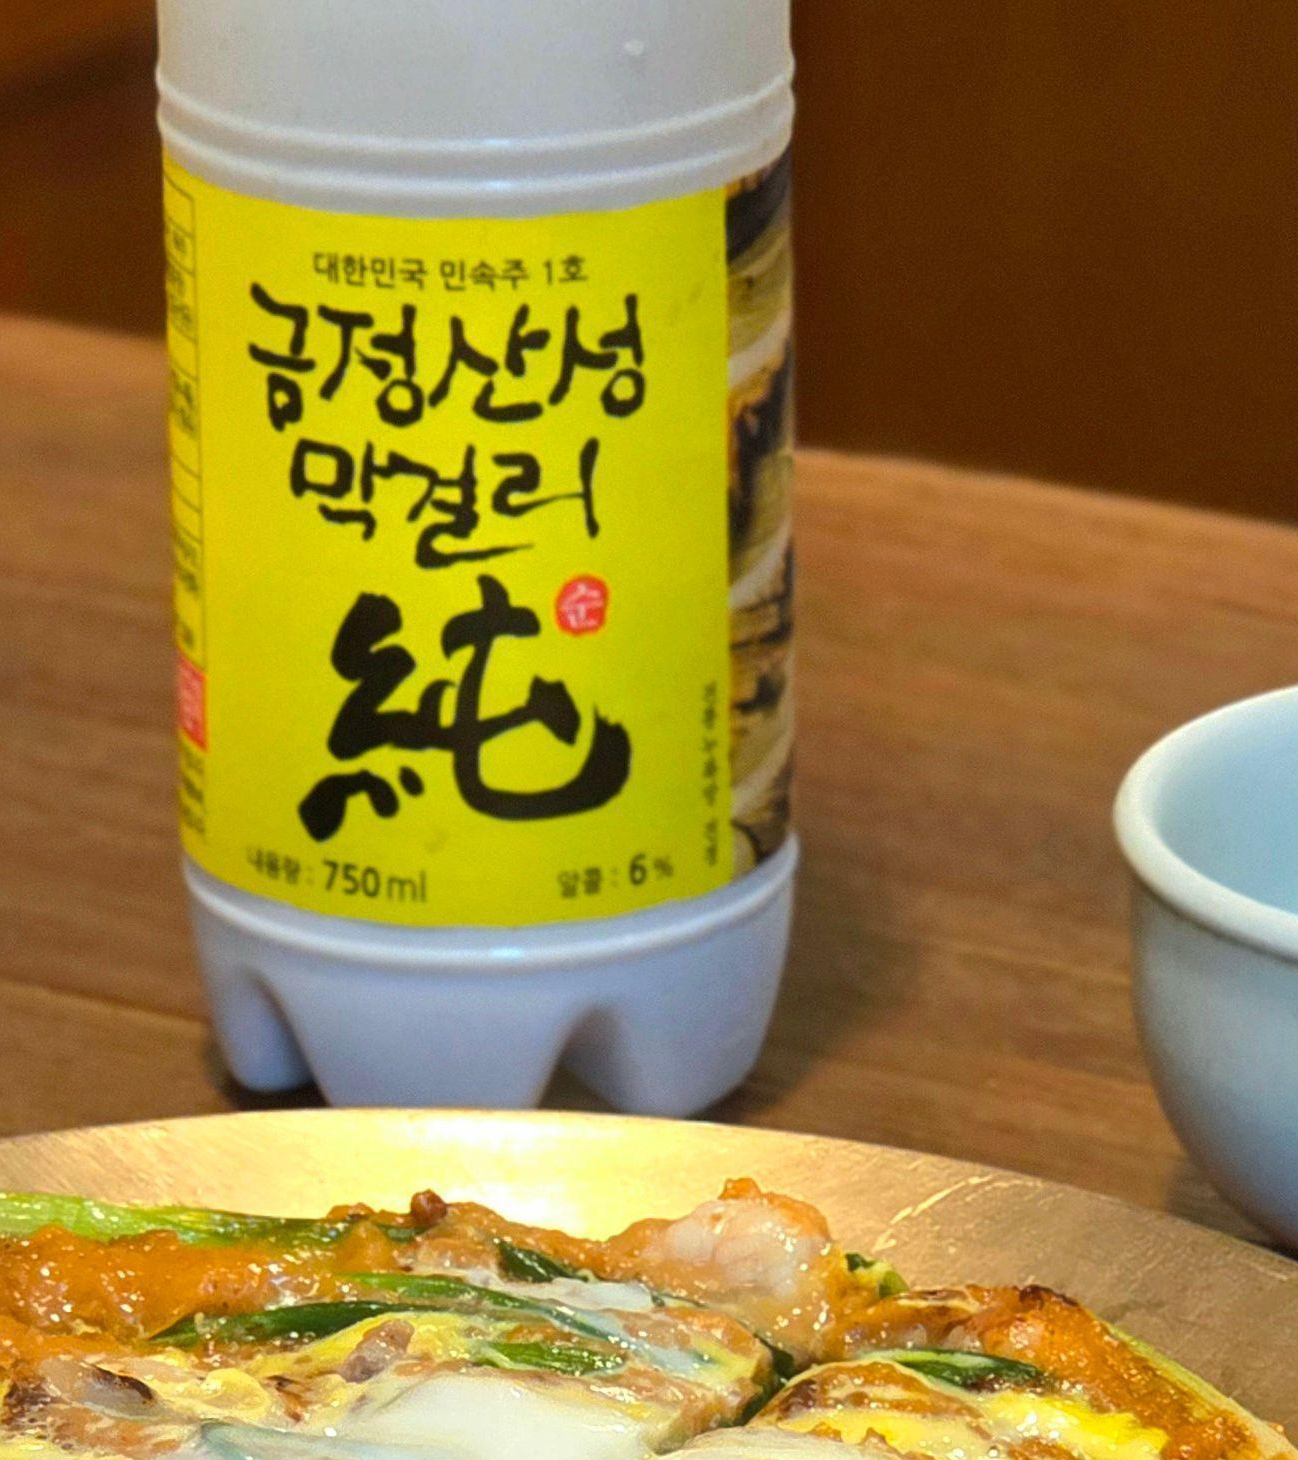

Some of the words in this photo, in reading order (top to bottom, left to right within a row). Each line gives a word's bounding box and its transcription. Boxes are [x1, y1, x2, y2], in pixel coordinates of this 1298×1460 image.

[313, 252, 428, 290] 대한민국
[439, 258, 530, 291] 민속주
[542, 254, 588, 285] 1호
[249, 281, 646, 431] 금정산성
[289, 437, 601, 568] 막걸리
[298, 573, 632, 842] 純
